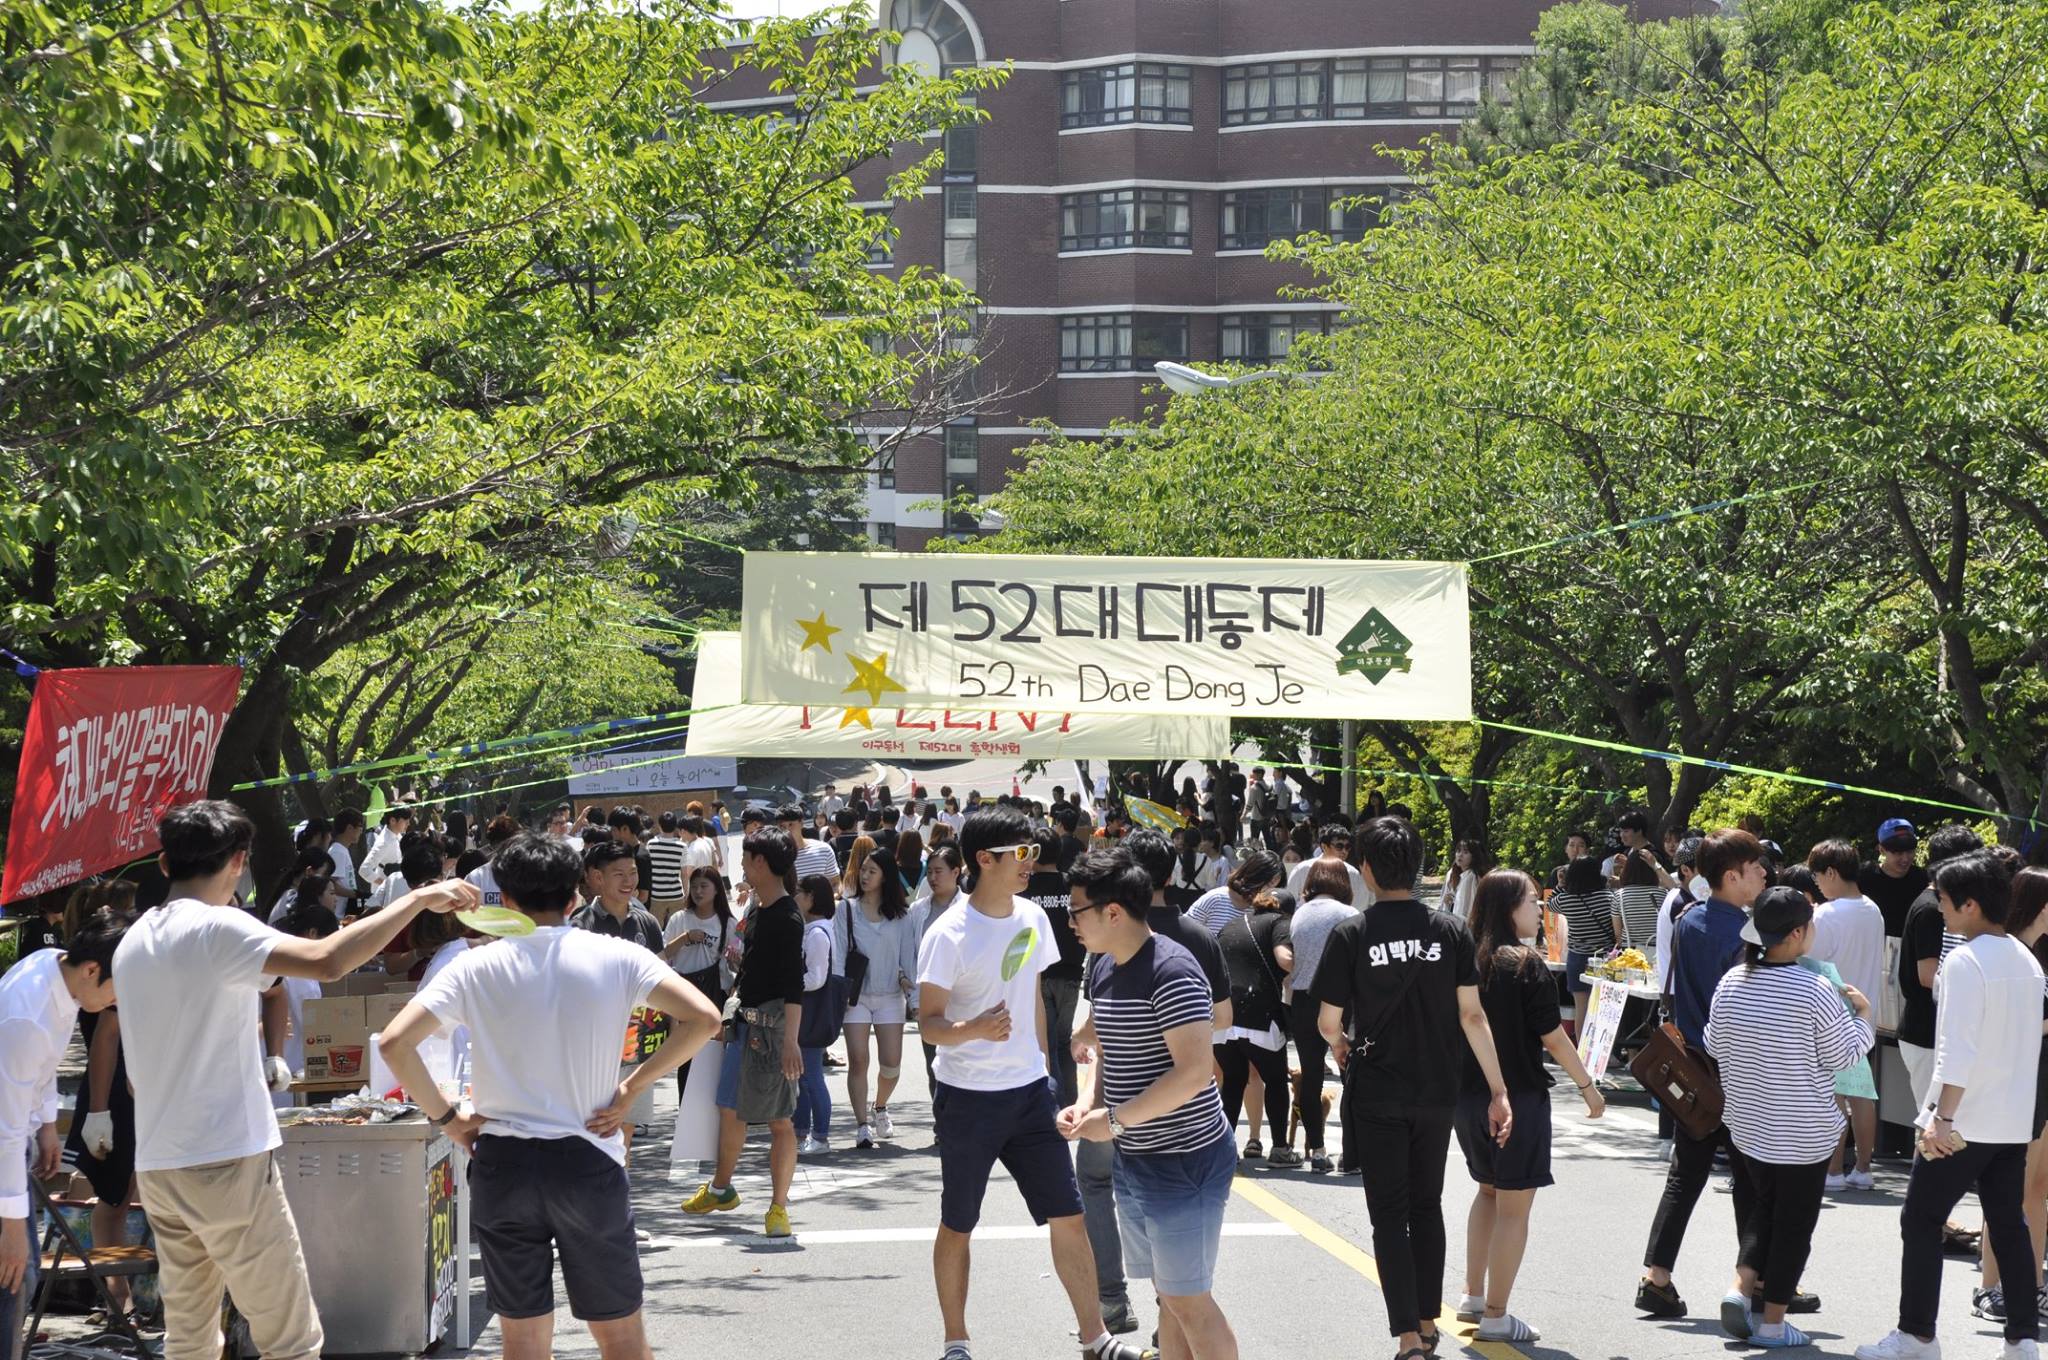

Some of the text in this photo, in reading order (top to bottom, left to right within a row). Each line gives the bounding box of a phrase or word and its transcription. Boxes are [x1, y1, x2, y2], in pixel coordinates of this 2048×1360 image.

[959, 660, 1305, 707] 52th Dae Dong Je
[862, 740, 905, 754] 이구동성
[649, 770, 670, 788] 오늘
